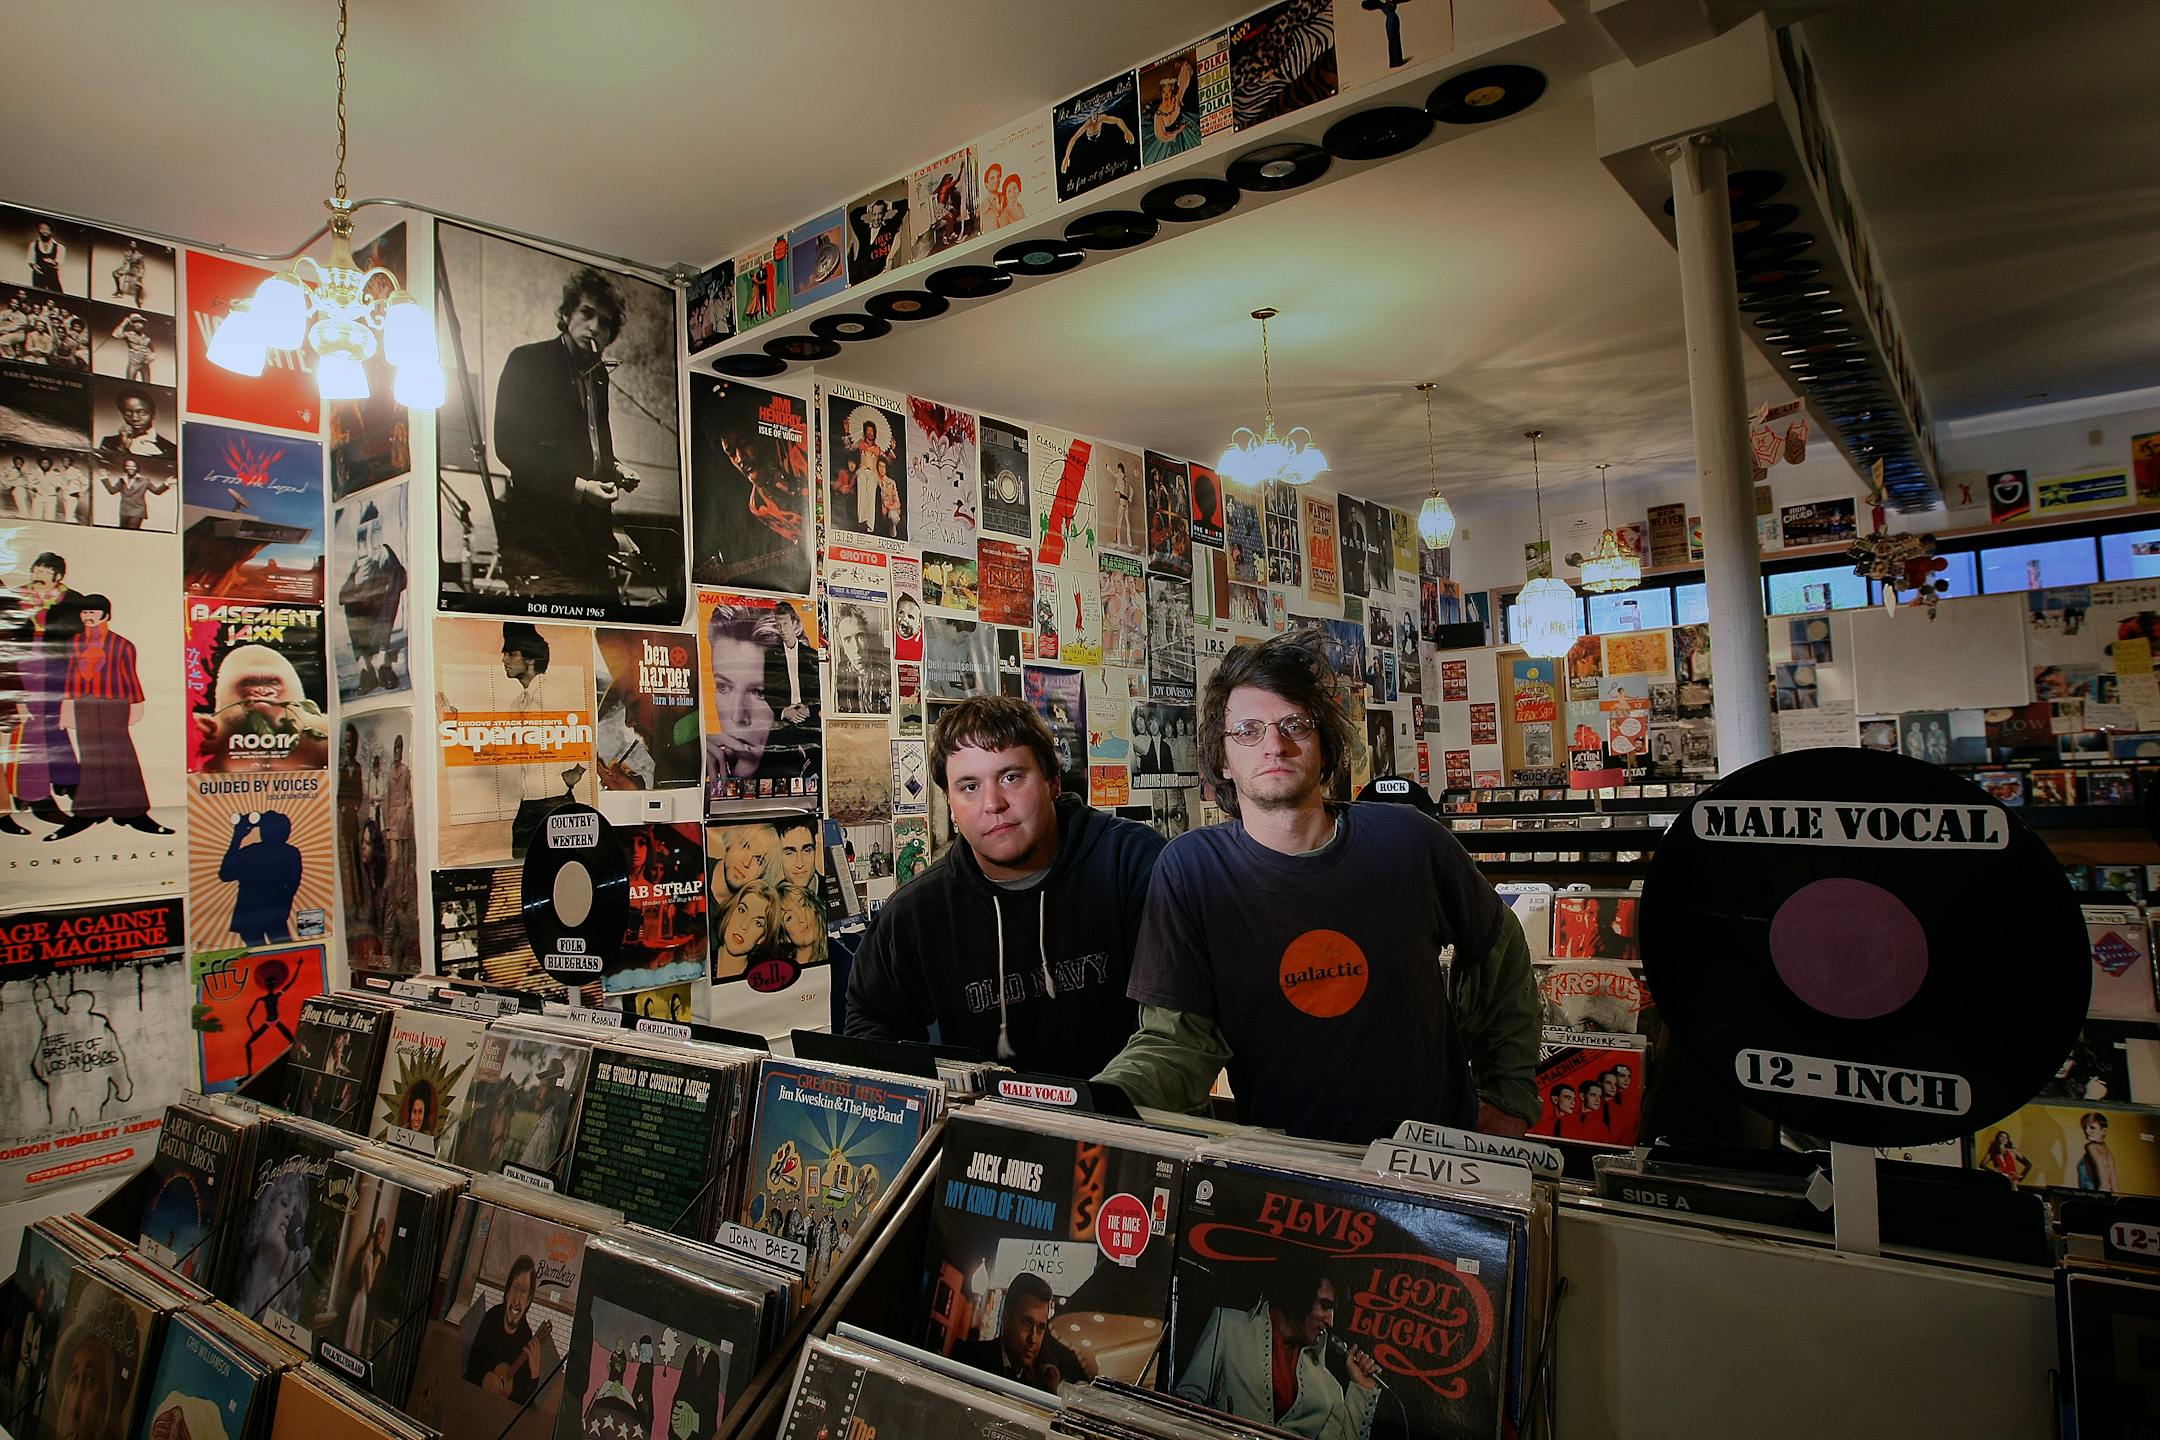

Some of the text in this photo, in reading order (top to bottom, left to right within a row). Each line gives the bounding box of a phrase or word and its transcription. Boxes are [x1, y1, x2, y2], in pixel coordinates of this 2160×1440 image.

[1198, 51, 1229, 74] POLKA
[1200, 66, 1229, 87] POLKA
[1200, 80, 1230, 100] POLKA
[1200, 94, 1231, 115] POLKA
[769, 395, 791, 413] JIMI
[833, 384, 901, 412] JIMI HENDRIX
[758, 406, 801, 428] HENDRIX
[758, 426, 802, 443] ISLE OF WIGHT
[1036, 435, 1057, 451] CLASH
[191, 603, 322, 628] BASEMENT
[527, 602, 606, 618] BOB DYLAN 1965
[225, 624, 286, 647] JAXX
[1204, 638, 1227, 654] I.R.S.
[642, 639, 670, 666] ben
[639, 660, 691, 688] harper
[1151, 686, 1194, 699] JOY DIVISION
[228, 733, 300, 750] ROOTY
[438, 712, 593, 754] Superrappin
[200, 778, 318, 795] GUIDED BY VOICES
[1380, 782, 1406, 792] ROCK
[1704, 806, 1999, 844] MALE VOCAL
[552, 833, 594, 847] WESTERN
[652, 880, 703, 899] STRAP
[0, 908, 169, 945] AGE AGAINST
[0, 926, 169, 966] HE MACHINE
[560, 939, 583, 952] FOLK
[547, 956, 599, 971] BLUEGRASS
[751, 961, 790, 989] Belly
[965, 951, 1099, 1014] OLD NAVY
[1285, 962, 1364, 990] galactic
[1548, 971, 1641, 1012] KROKUS
[301, 1004, 319, 1025] Roy
[320, 1008, 349, 1027] Clark
[43, 1033, 68, 1046] THE
[392, 1026, 419, 1044] Loretta
[639, 1021, 688, 1038] COMPILATIONS
[1566, 1032, 1616, 1046] KRAFTWERK
[43, 1037, 102, 1058] BATTLE OF
[597, 1062, 612, 1081] THE
[612, 1065, 638, 1086] WORLD
[637, 1070, 649, 1088] OF
[649, 1073, 684, 1094] COUNTRY
[684, 1079, 710, 1101] MUSIC
[1541, 1053, 1591, 1087] MACHINE
[797, 1074, 887, 1104] GREATEST HITS!
[1002, 1082, 1072, 1103] MALE VOCAL
[1746, 1053, 1795, 1090] 12
[1834, 1064, 1959, 1112] INCH
[778, 1084, 905, 1124] Jim Kweskin & The Jug Band
[0, 1118, 162, 1161] ONDON WEMBLEY ARENA
[163, 1111, 229, 1155] LARRY GATLIN
[160, 1132, 216, 1175] GATLIN BROS.
[1404, 1123, 1560, 1171] NEIL DIAMOND
[967, 1151, 1044, 1193] JACK JONES
[1156, 1160, 1174, 1174] stereo
[1389, 1149, 1482, 1185] ELVIS
[944, 1180, 1057, 1232] MY KIND OF TOWN
[1622, 1187, 1691, 1211] SIDE A
[1107, 1214, 1142, 1233] THE RACE
[1257, 1191, 1376, 1248] ELVIS
[728, 1226, 801, 1266] JOAN BAEZ
[1027, 1242, 1061, 1258] JACK
[1112, 1231, 1133, 1249] IS ON
[536, 1259, 576, 1284] Bromberg
[1020, 1258, 1065, 1274] JONES
[1389, 1272, 1463, 1312] GOT
[1348, 1305, 1462, 1358] LUCKY
[199, 1342, 232, 1378] WILLIAMSON
[847, 1416, 877, 1440] The
